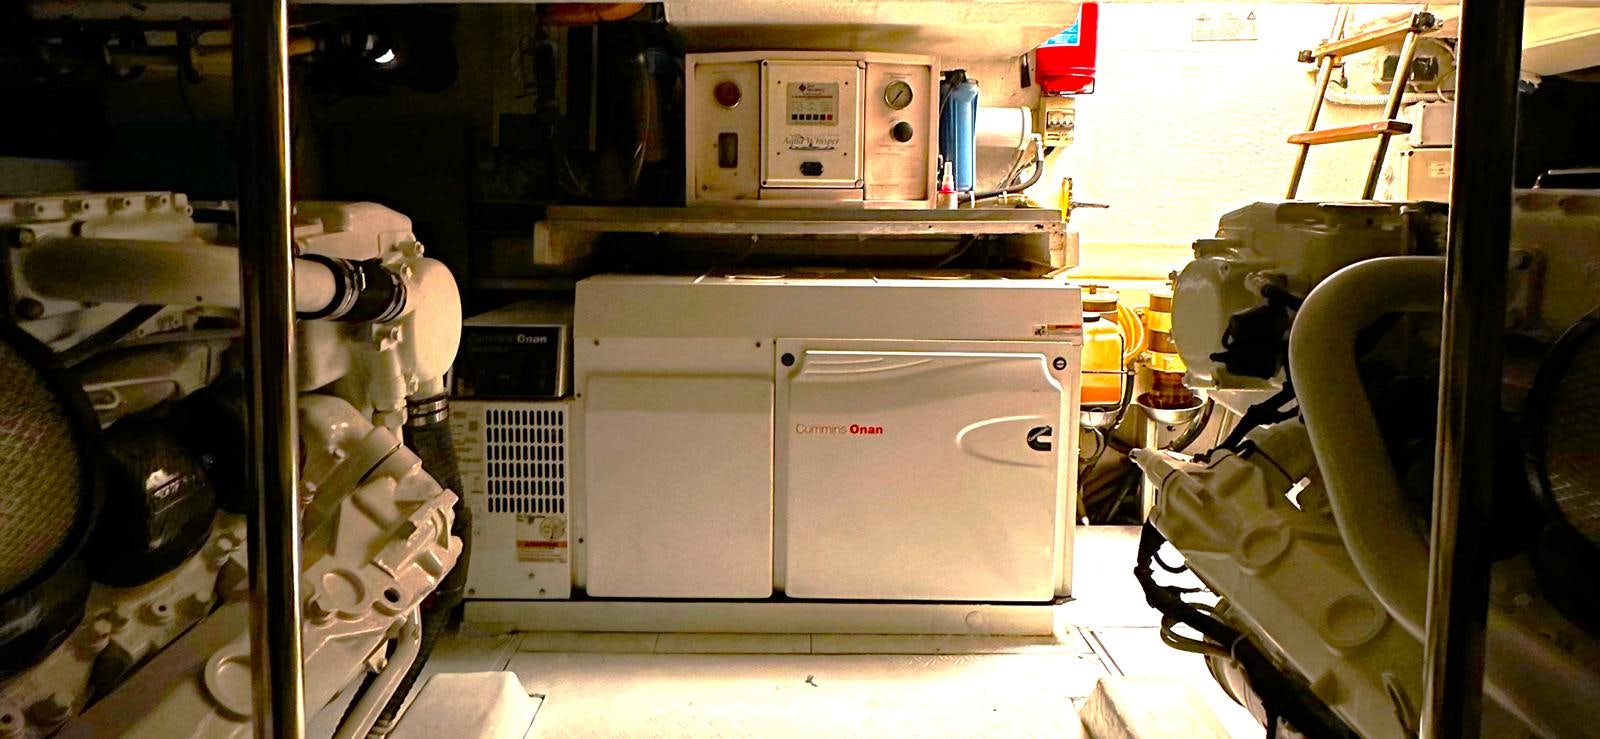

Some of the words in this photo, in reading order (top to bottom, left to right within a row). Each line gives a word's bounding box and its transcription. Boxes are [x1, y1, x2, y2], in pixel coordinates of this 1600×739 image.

[516, 334, 548, 344] Onan
[795, 423, 847, 434] Cummins
[849, 423, 884, 434] Onan
